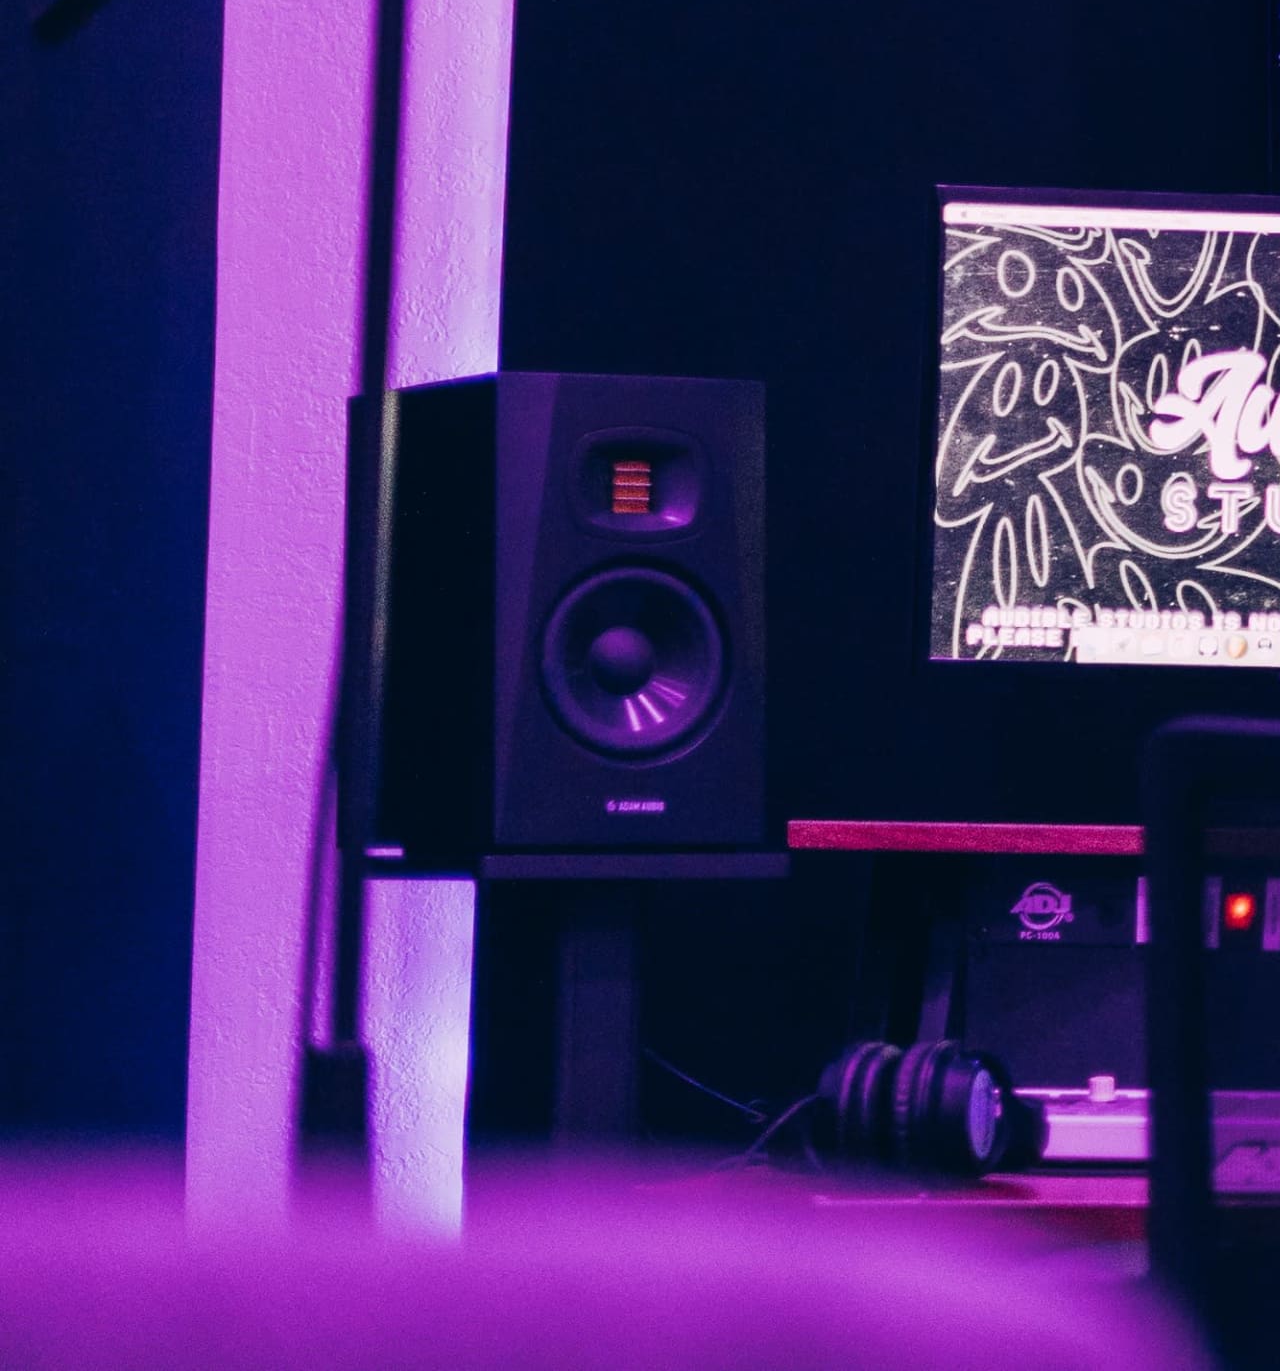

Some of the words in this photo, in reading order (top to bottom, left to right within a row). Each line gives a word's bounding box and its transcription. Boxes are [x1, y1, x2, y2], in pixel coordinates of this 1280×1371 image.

[982, 606, 1086, 628] AUDIBLE
[1099, 608, 1204, 630] STUDIOS
[1213, 611, 1242, 631] IS
[966, 625, 1064, 647] PLEASE
